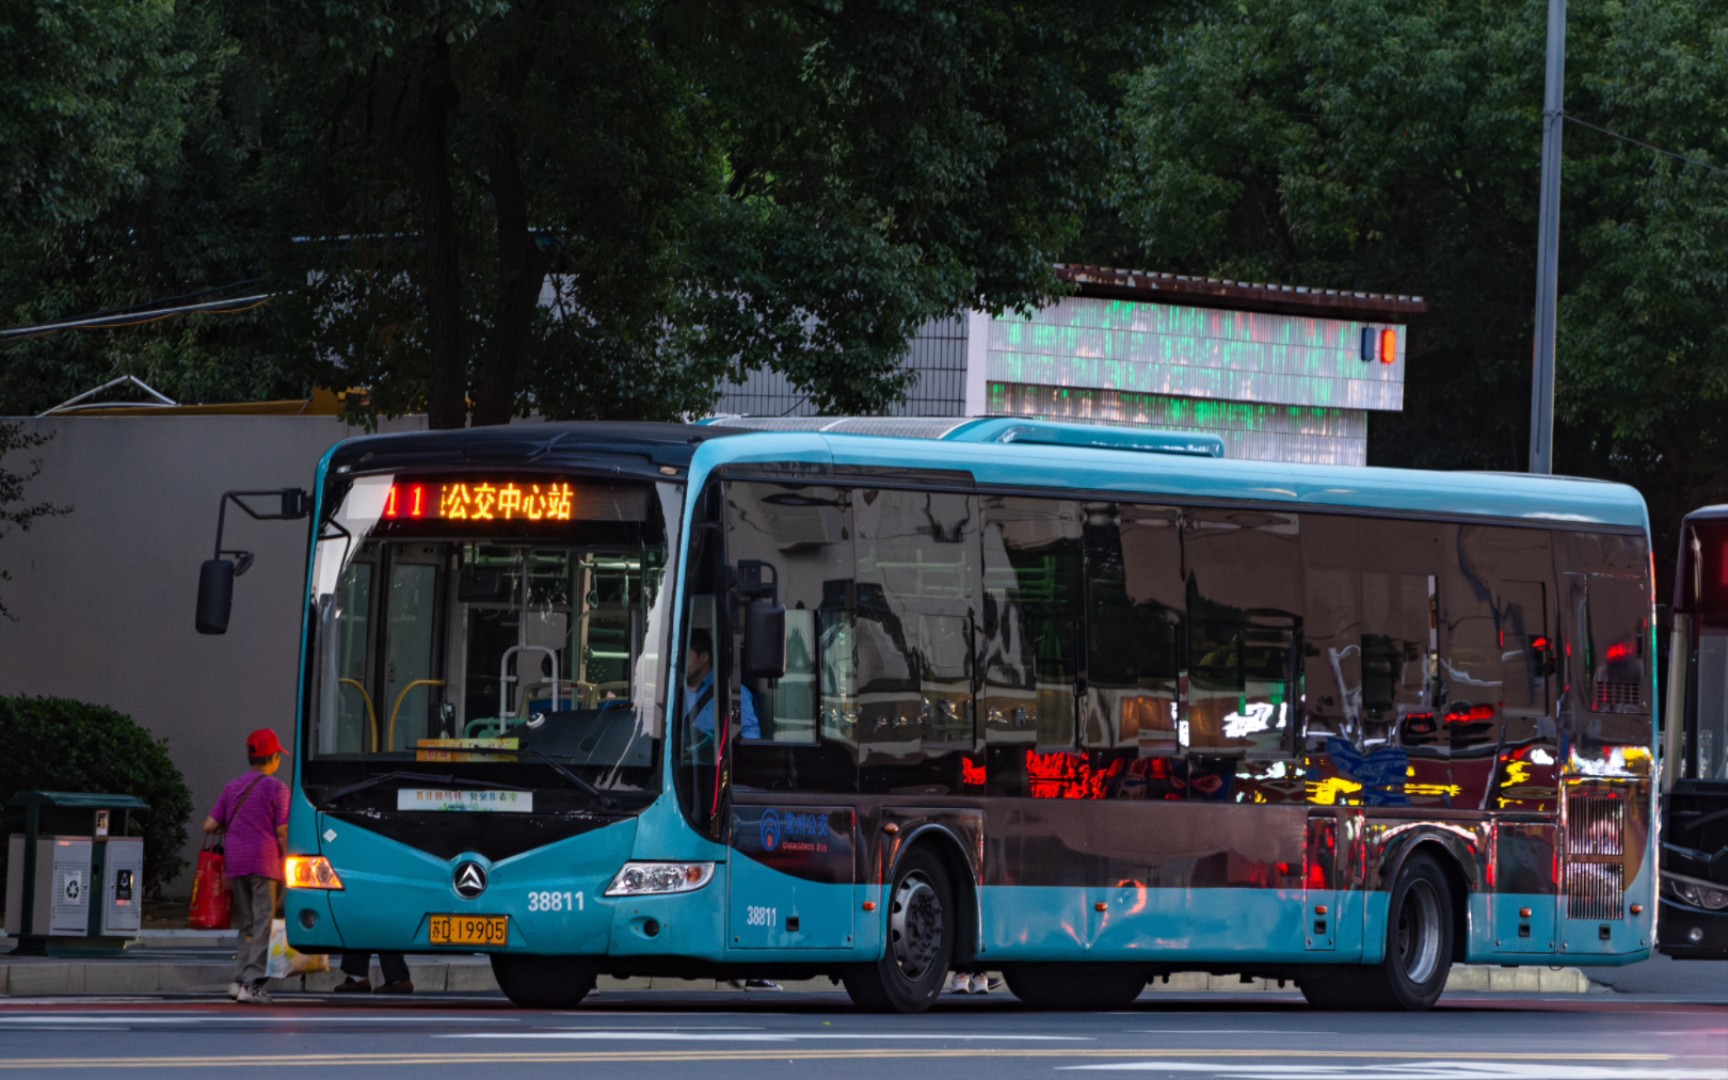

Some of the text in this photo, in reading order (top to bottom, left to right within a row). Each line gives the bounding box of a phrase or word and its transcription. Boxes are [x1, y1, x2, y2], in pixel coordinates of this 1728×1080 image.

[386, 485, 422, 517] 11
[527, 891, 585, 912] 38811
[747, 905, 777, 927] 38811
